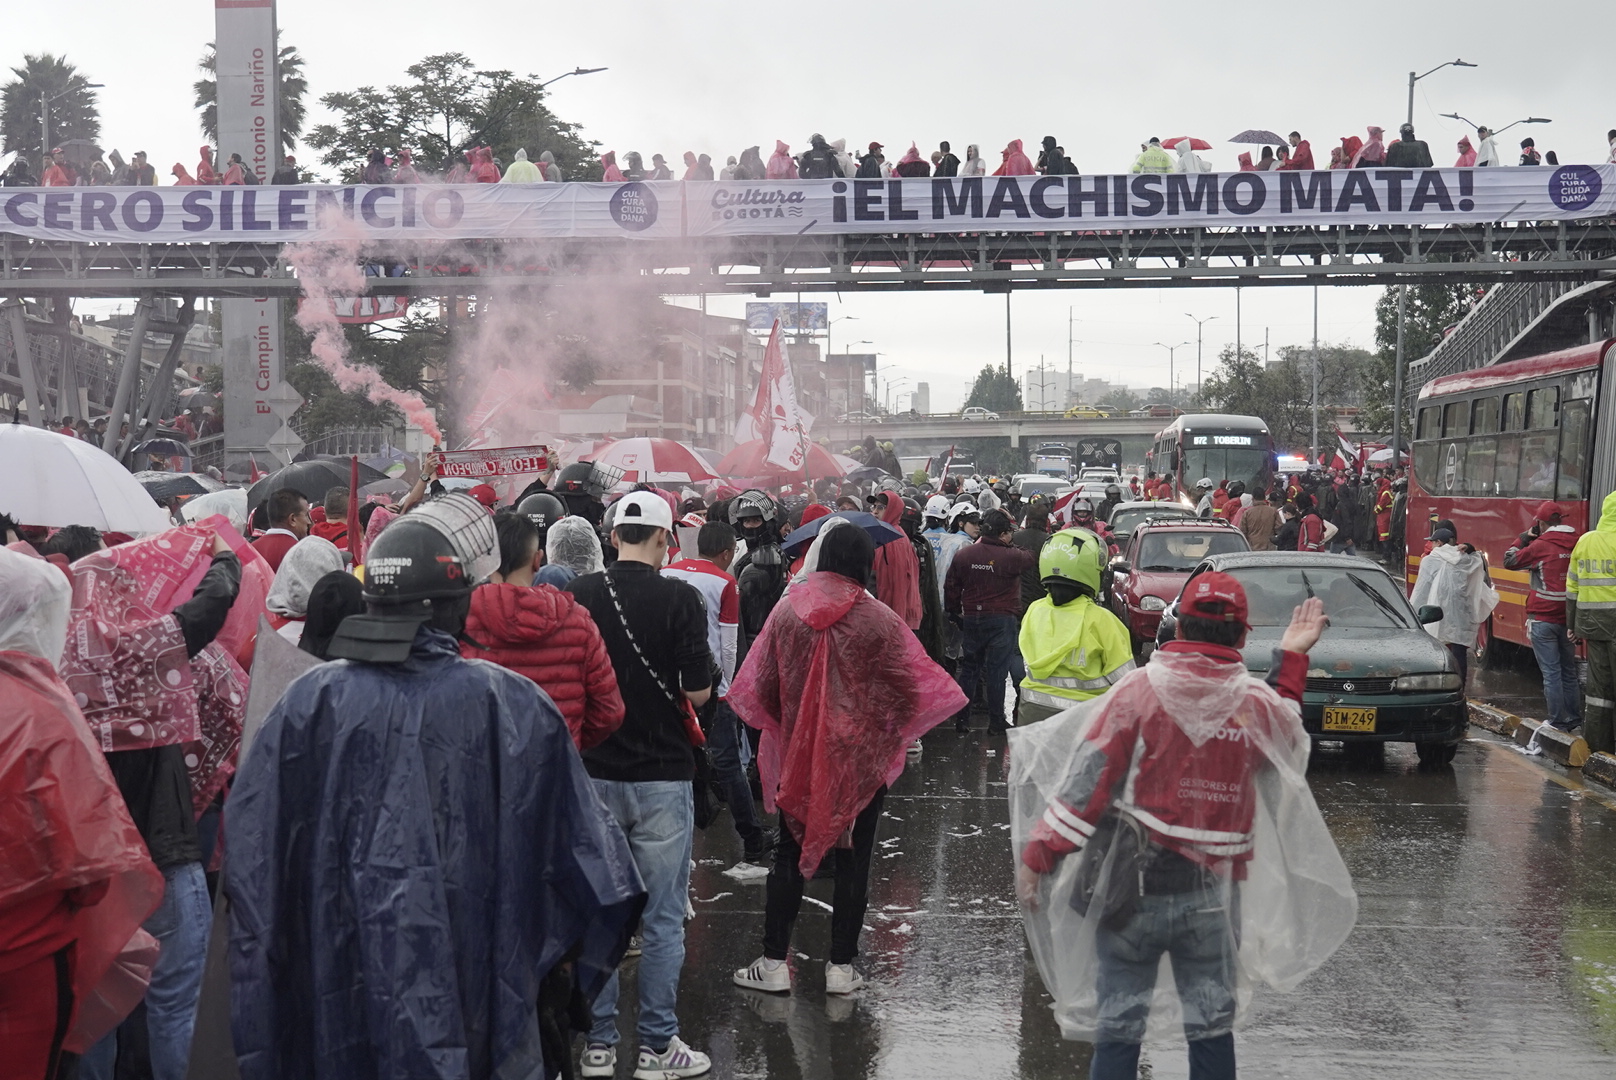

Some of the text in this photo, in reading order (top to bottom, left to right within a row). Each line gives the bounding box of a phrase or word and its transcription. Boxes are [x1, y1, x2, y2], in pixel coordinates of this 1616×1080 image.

[248, 47, 265, 107] Nariño
[622, 190, 639, 198] CUL
[832, 170, 1475, 223] ¡EL MACHISMO MATA!
[1561, 186, 1591, 195] CIUDA
[621, 198, 645, 206] TURA
[711, 188, 806, 209] Cultura
[1561, 194, 1588, 204] DANA
[4, 186, 465, 232] CERO SILENCIO
[621, 206, 648, 215] CIUDA
[621, 214, 645, 223] DANA
[253, 325, 273, 391] Campín
[1213, 435, 1252, 445] TOBERIN
[78, 632, 88, 659] SANTA
[1180, 777, 1227, 791] GESTORES
[1177, 789, 1241, 803] CONVIVENCIA
